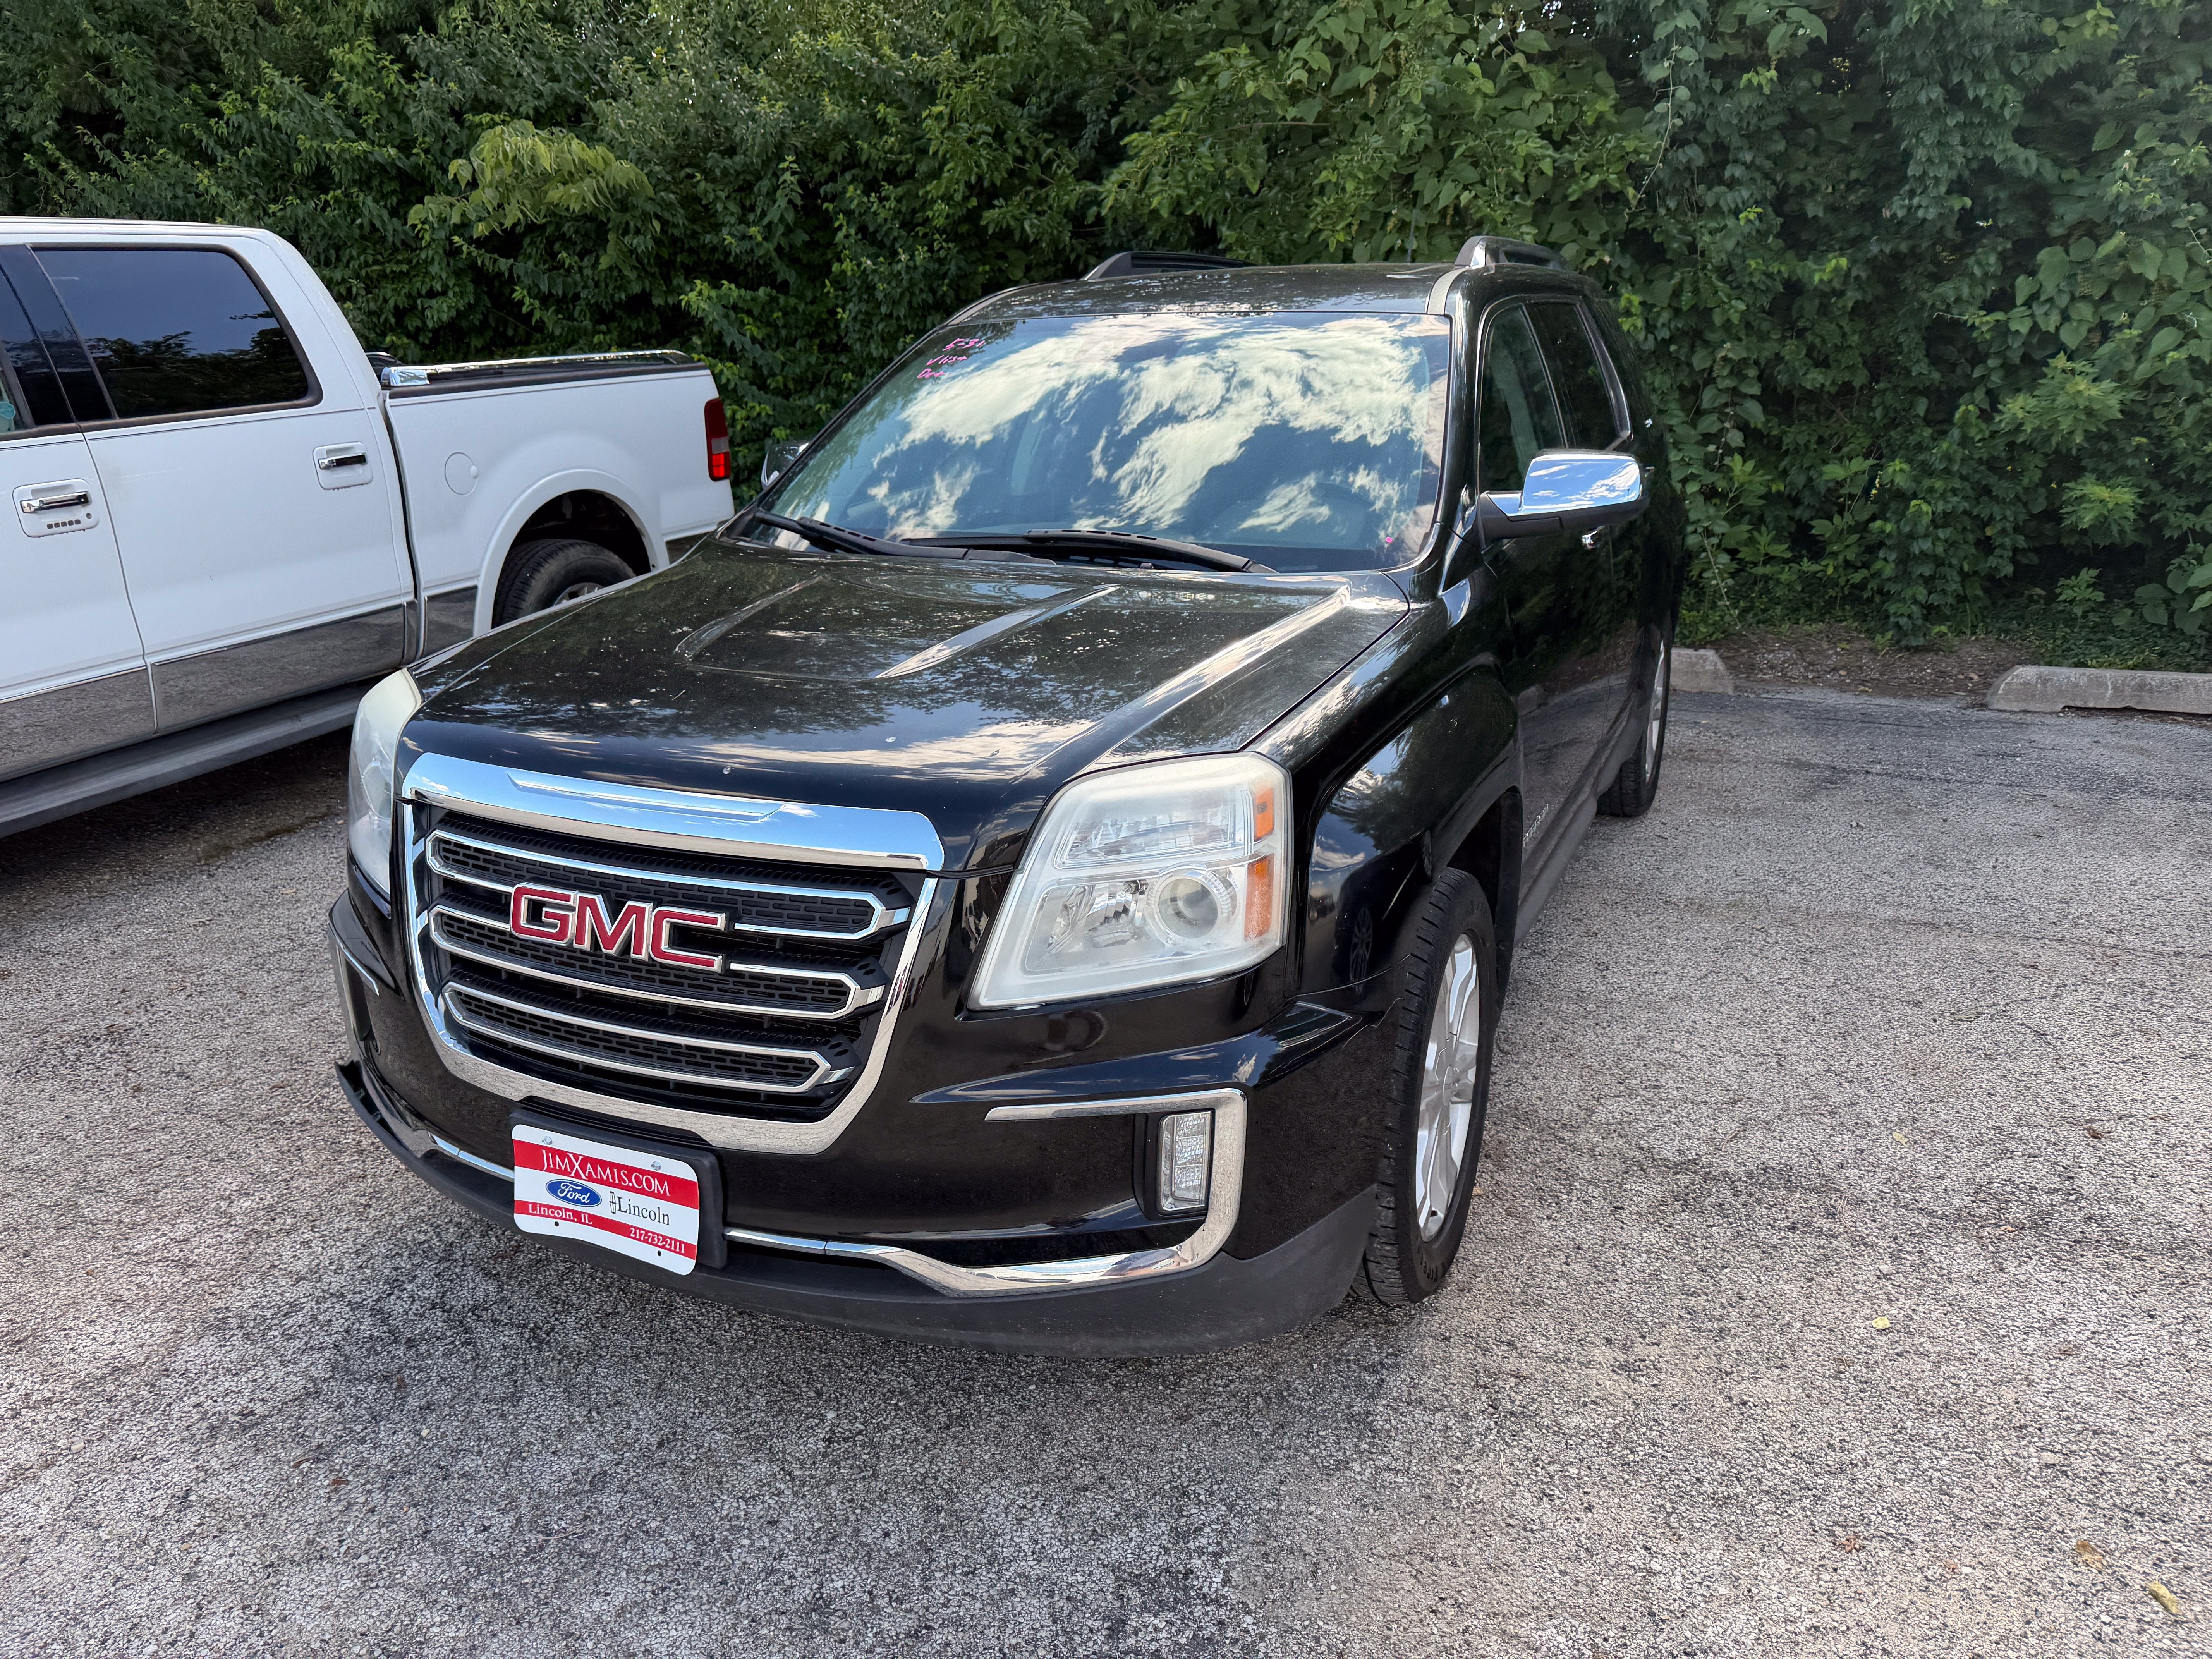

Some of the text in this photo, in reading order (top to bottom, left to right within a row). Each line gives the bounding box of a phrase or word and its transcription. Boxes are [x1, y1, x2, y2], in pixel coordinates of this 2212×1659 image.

[510, 881, 726, 973] GMC
[557, 1182, 591, 1204] Ford
[528, 1203, 593, 1225] Lincoln, IL
[617, 1196, 670, 1226] Lincoln
[629, 1227, 685, 1254] 217-732-2111
